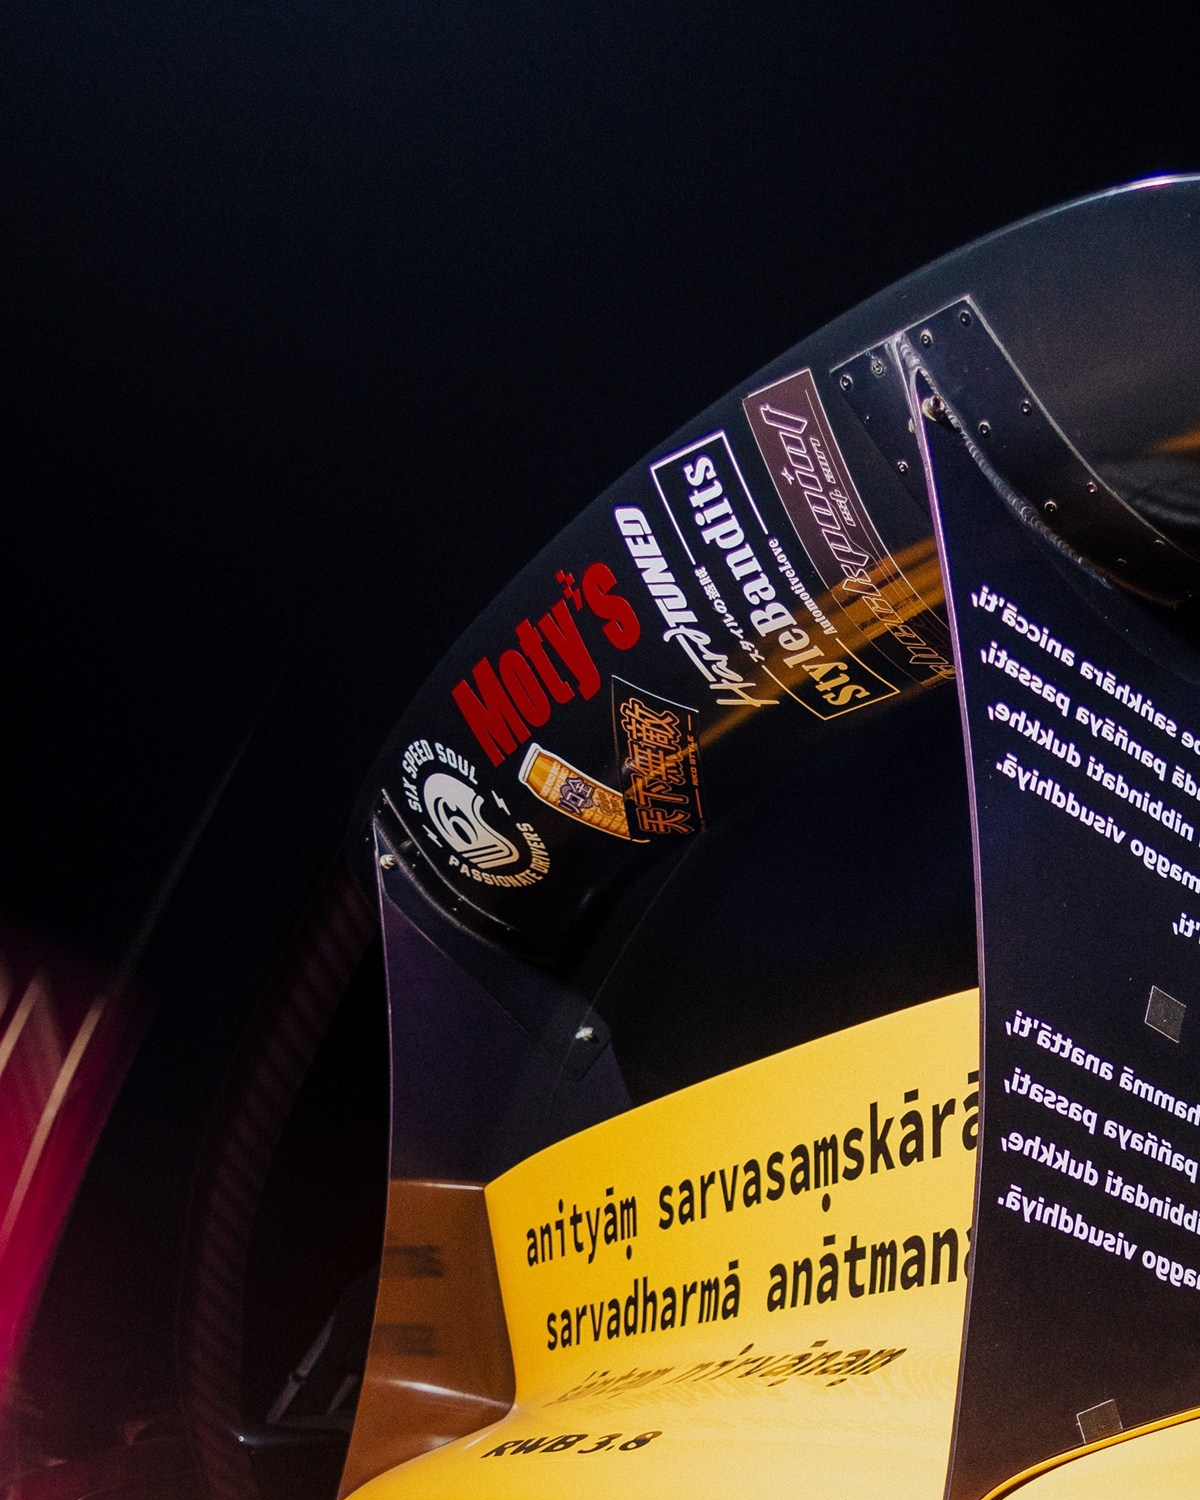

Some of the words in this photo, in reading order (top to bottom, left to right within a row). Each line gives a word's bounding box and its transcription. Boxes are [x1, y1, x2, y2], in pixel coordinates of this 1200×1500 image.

[768, 537, 840, 637] AutomotiveLove
[450, 560, 643, 768] Moty's
[402, 739, 435, 780] SPEED
[434, 742, 480, 785] SOUL
[620, 697, 697, 835] 天下無敵
[402, 776, 424, 814] SIX
[448, 854, 544, 888] PASSIONATE
[515, 822, 551, 874] DRIVERS
[546, 1260, 741, 1351] sarvadharmā
[767, 1226, 973, 1313] anātman
[480, 1433, 589, 1459] RWB
[577, 1430, 664, 1455] 3.8
